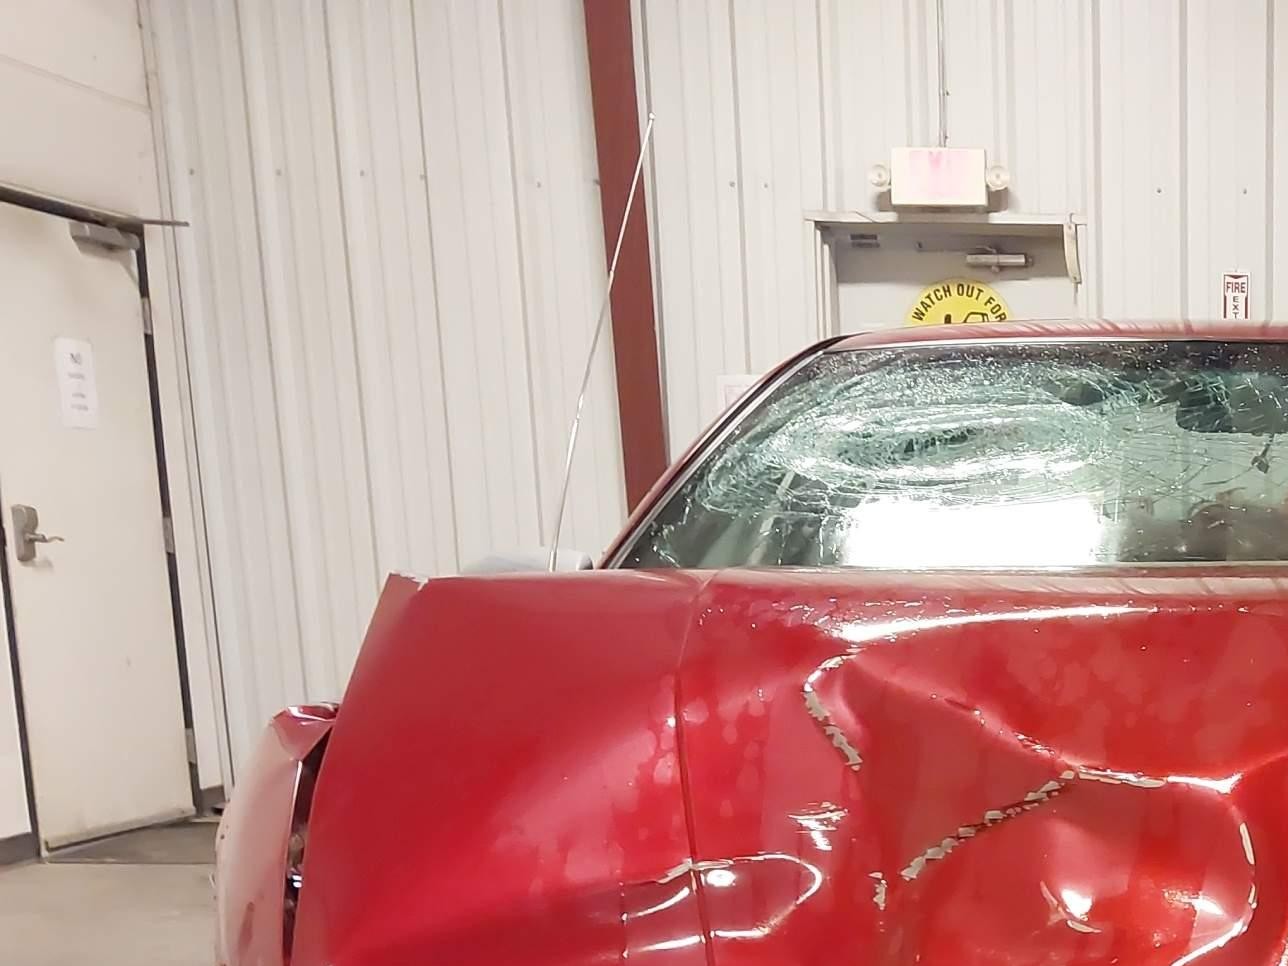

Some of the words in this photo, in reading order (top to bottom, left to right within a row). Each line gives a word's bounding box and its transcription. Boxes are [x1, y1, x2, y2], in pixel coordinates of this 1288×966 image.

[1226, 282, 1246, 293] FIRE
[912, 283, 952, 321] WATCH
[957, 283, 984, 301] OUT
[984, 296, 1007, 322] FOR
